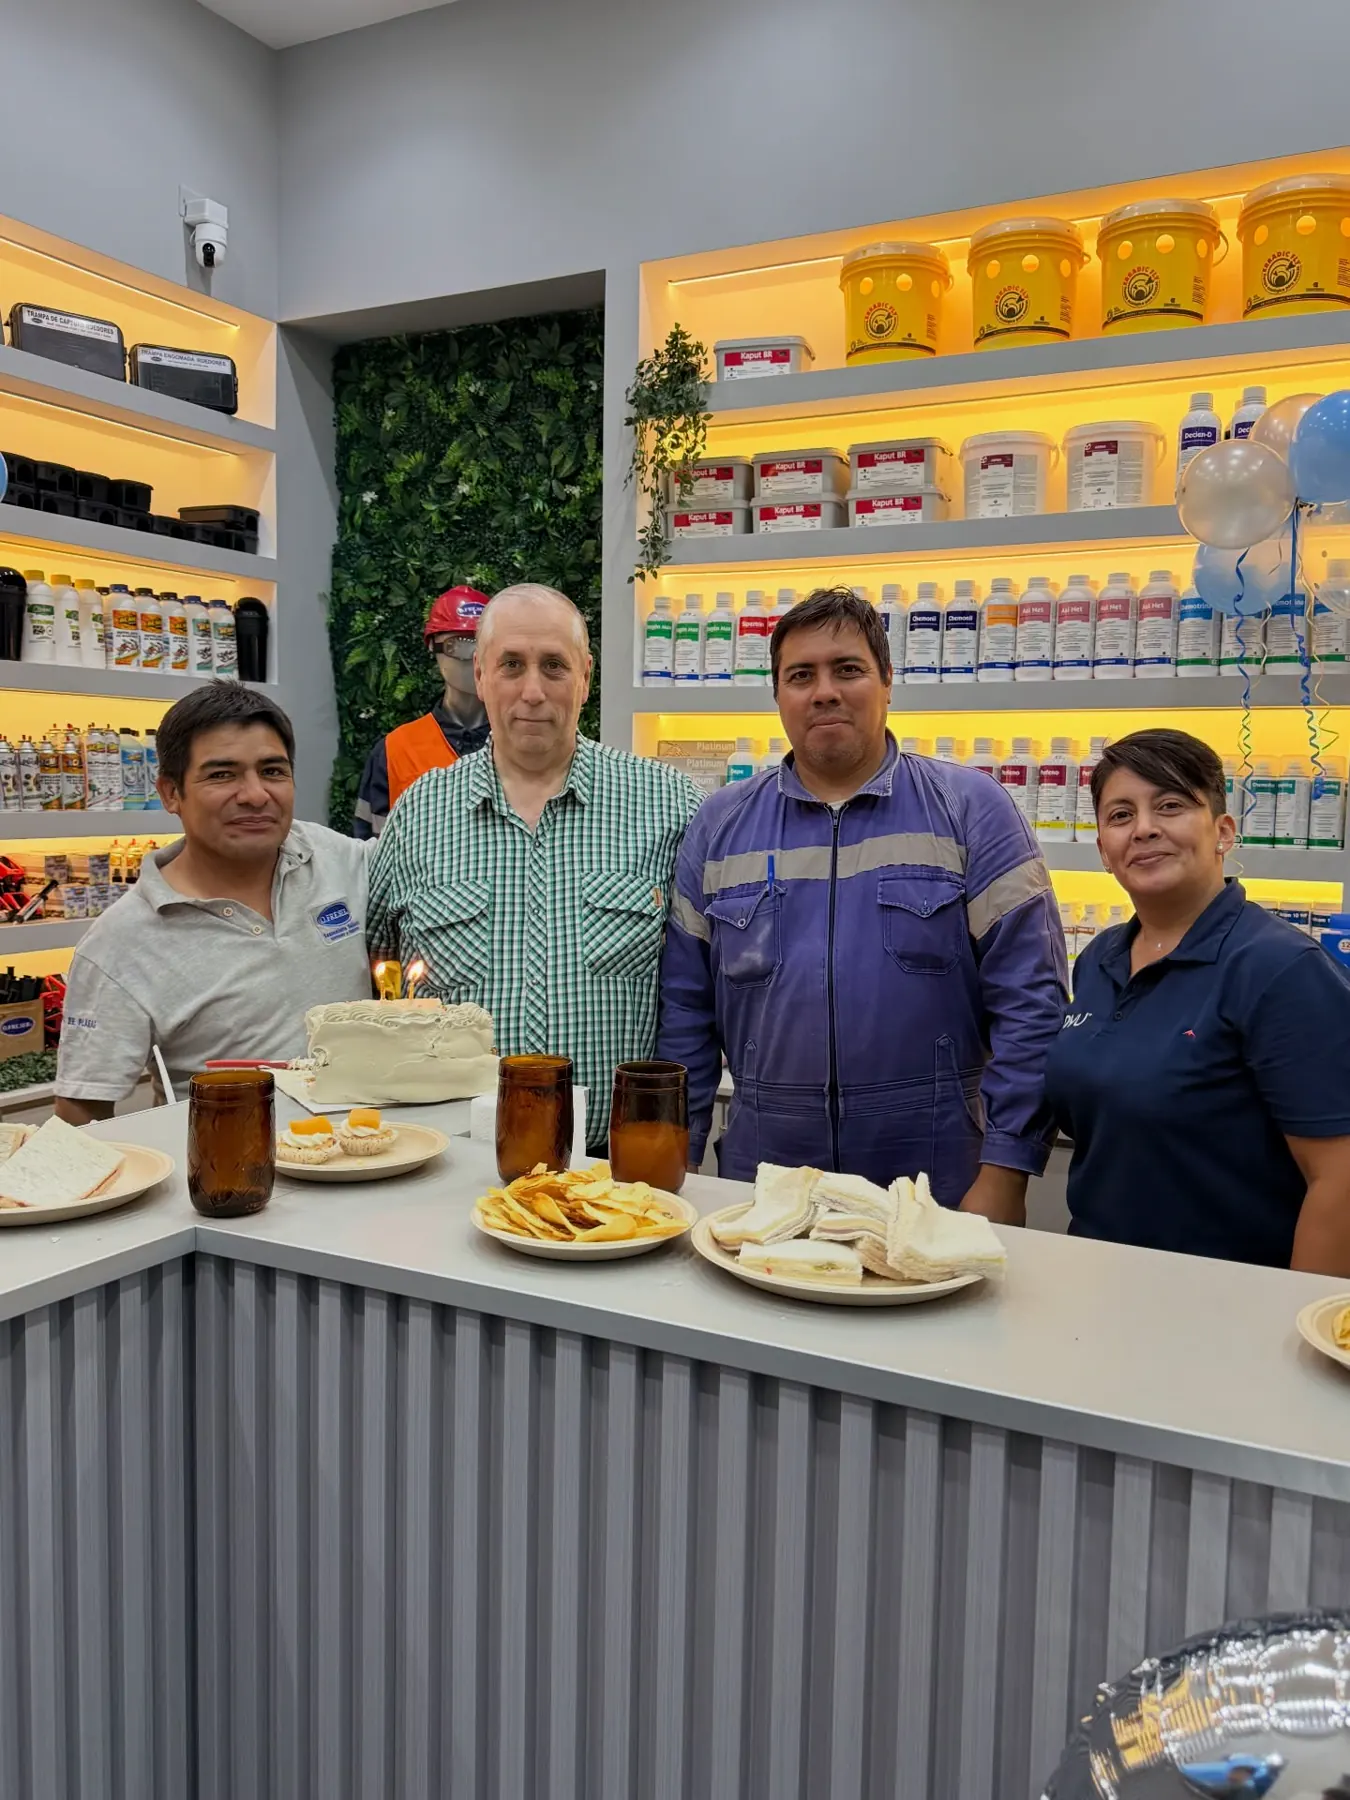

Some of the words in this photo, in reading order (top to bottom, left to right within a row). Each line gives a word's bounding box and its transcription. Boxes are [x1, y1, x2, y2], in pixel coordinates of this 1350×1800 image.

[27, 309, 49, 321] TRAMPA
[50, 315, 58, 323] DE
[741, 351, 762, 360] Kaput
[763, 350, 773, 358] BR
[874, 452, 895, 461] Kaput
[897, 450, 906, 458] BR
[775, 462, 796, 471] Kaput
[796, 461, 805, 469] BR
[709, 467, 717, 476] BR
[872, 499, 893, 508] Kaput
[894, 498, 904, 506] BR
[774, 506, 794, 515] Kaput
[795, 505, 804, 513] BR
[688, 513, 707, 522] Kaput
[696, 742, 734, 751] Platinum
[686, 759, 725, 768] Platinum
